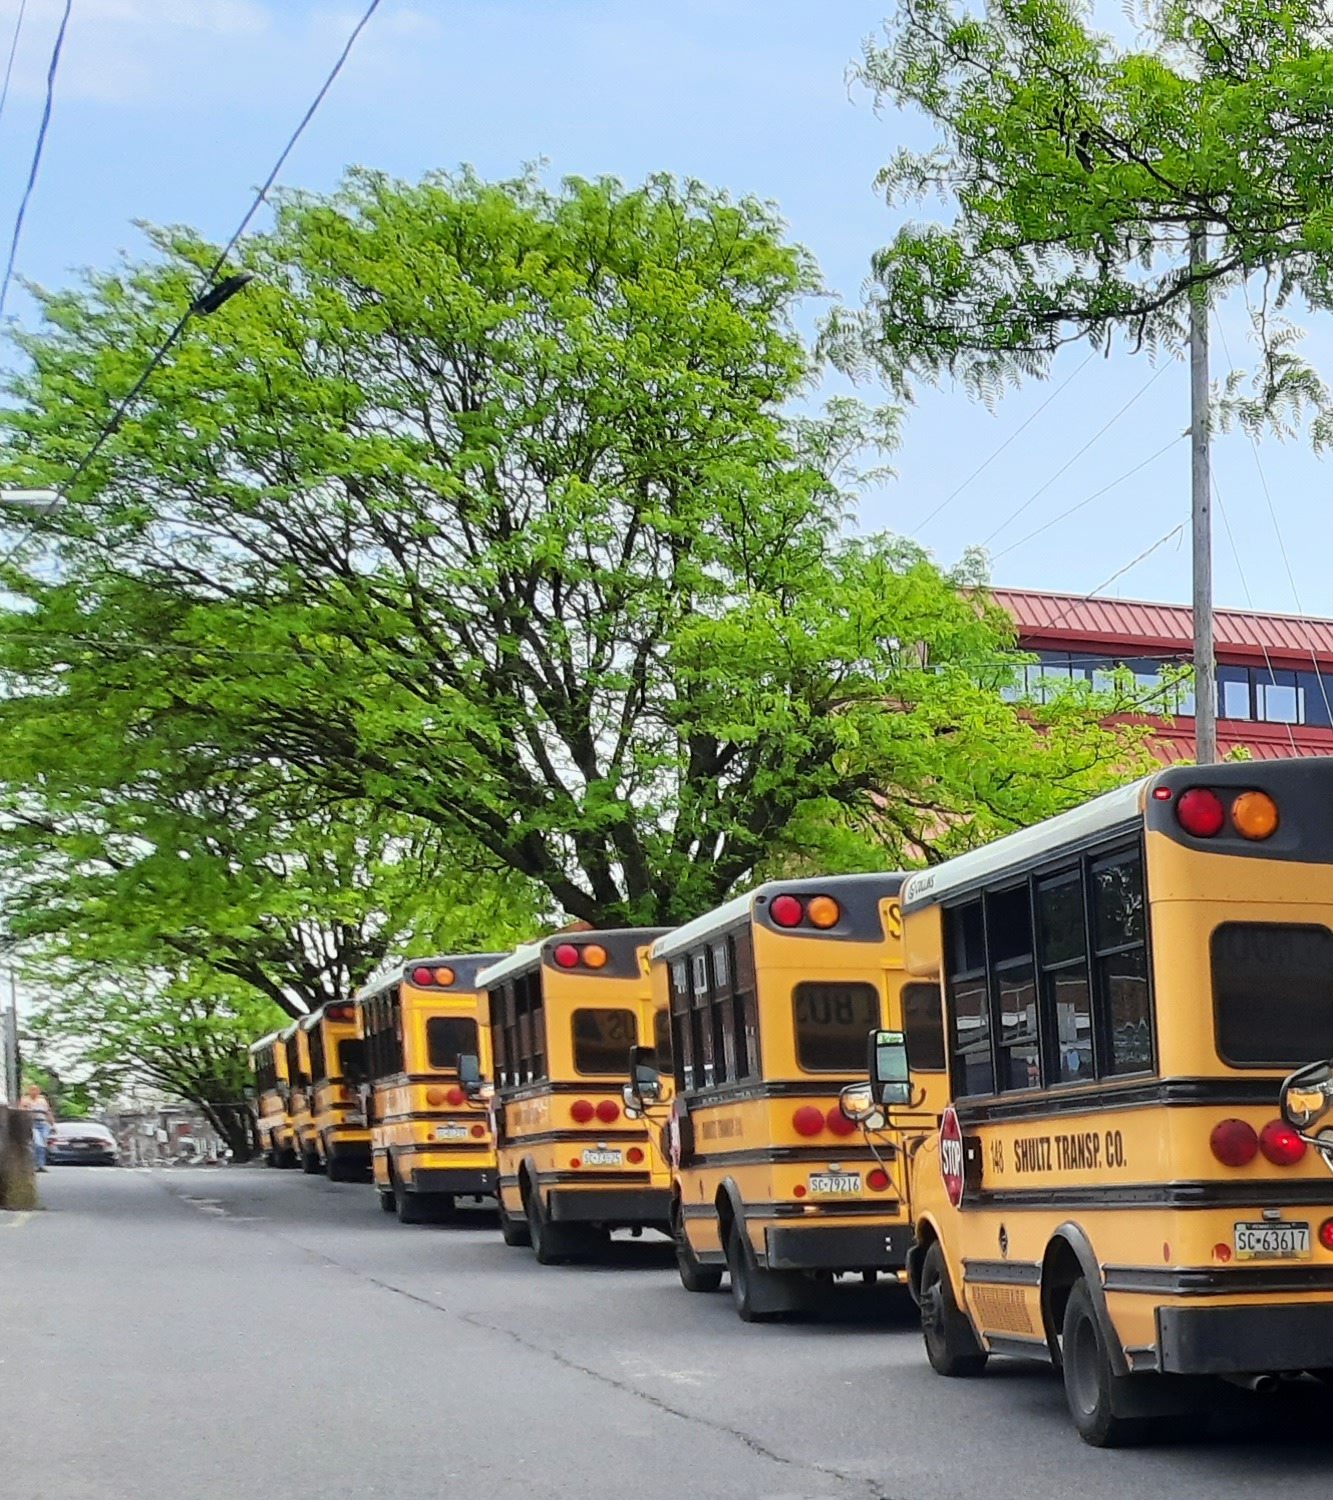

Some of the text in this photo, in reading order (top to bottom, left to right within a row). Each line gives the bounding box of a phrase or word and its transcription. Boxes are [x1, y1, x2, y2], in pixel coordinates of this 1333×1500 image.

[942, 1138, 961, 1176] STOP
[1013, 1130, 1127, 1173] SHULTZ TRANSP. CO.
